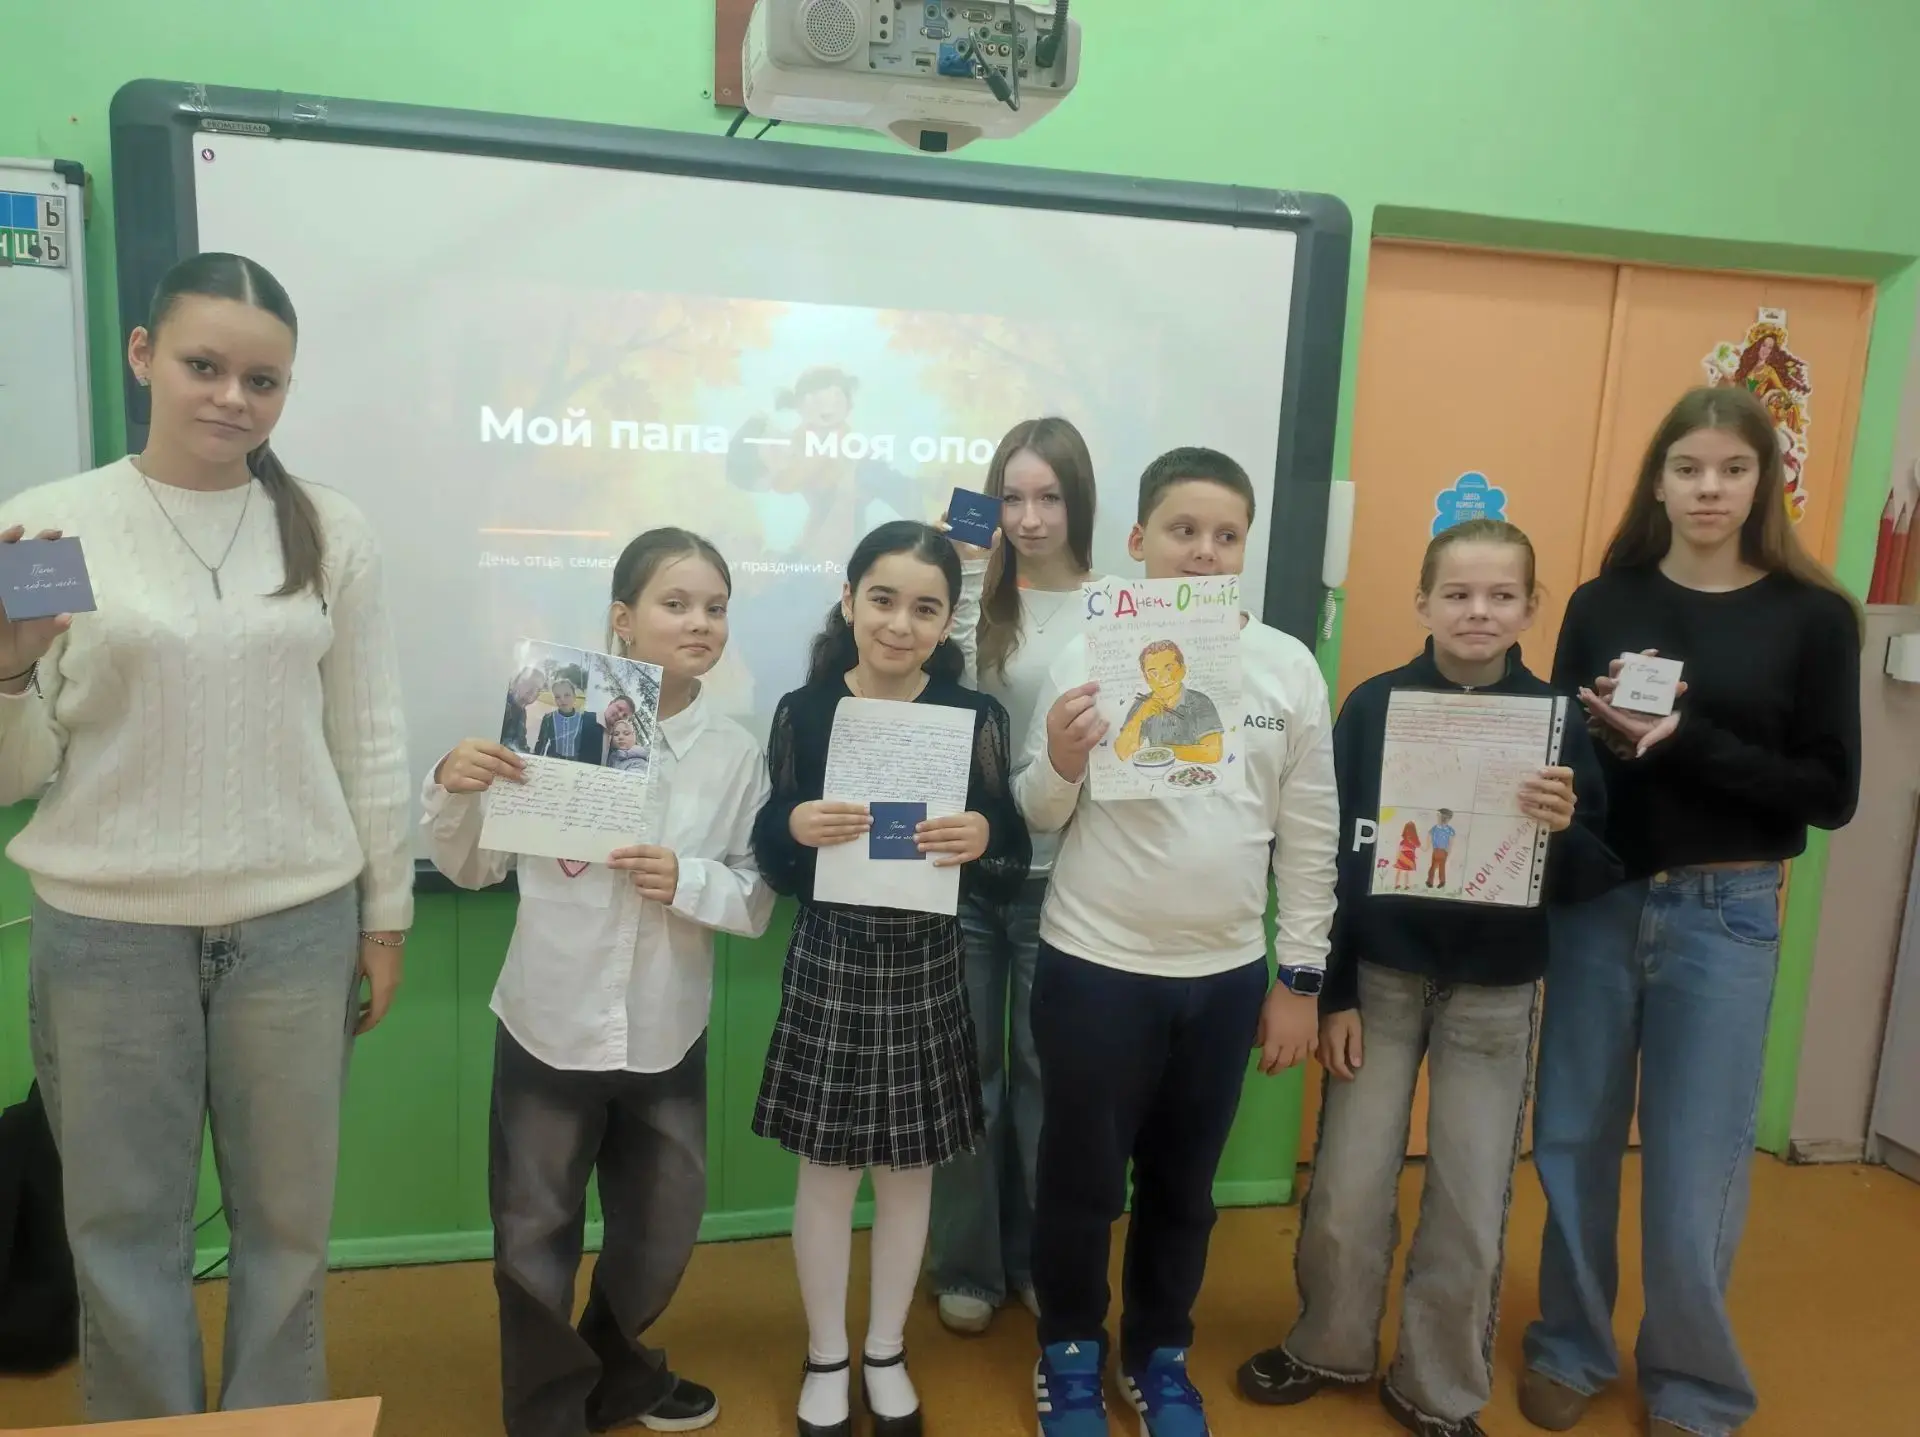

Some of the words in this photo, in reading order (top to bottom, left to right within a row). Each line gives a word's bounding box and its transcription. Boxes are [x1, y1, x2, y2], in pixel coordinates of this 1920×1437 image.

[480, 405, 592, 448] Мой
[611, 420, 729, 454] папа
[805, 430, 896, 462] моя
[909, 436, 1002, 465] опо
[478, 552, 520, 568] День
[742, 560, 821, 576] праздники
[1244, 714, 1286, 733] AGES
